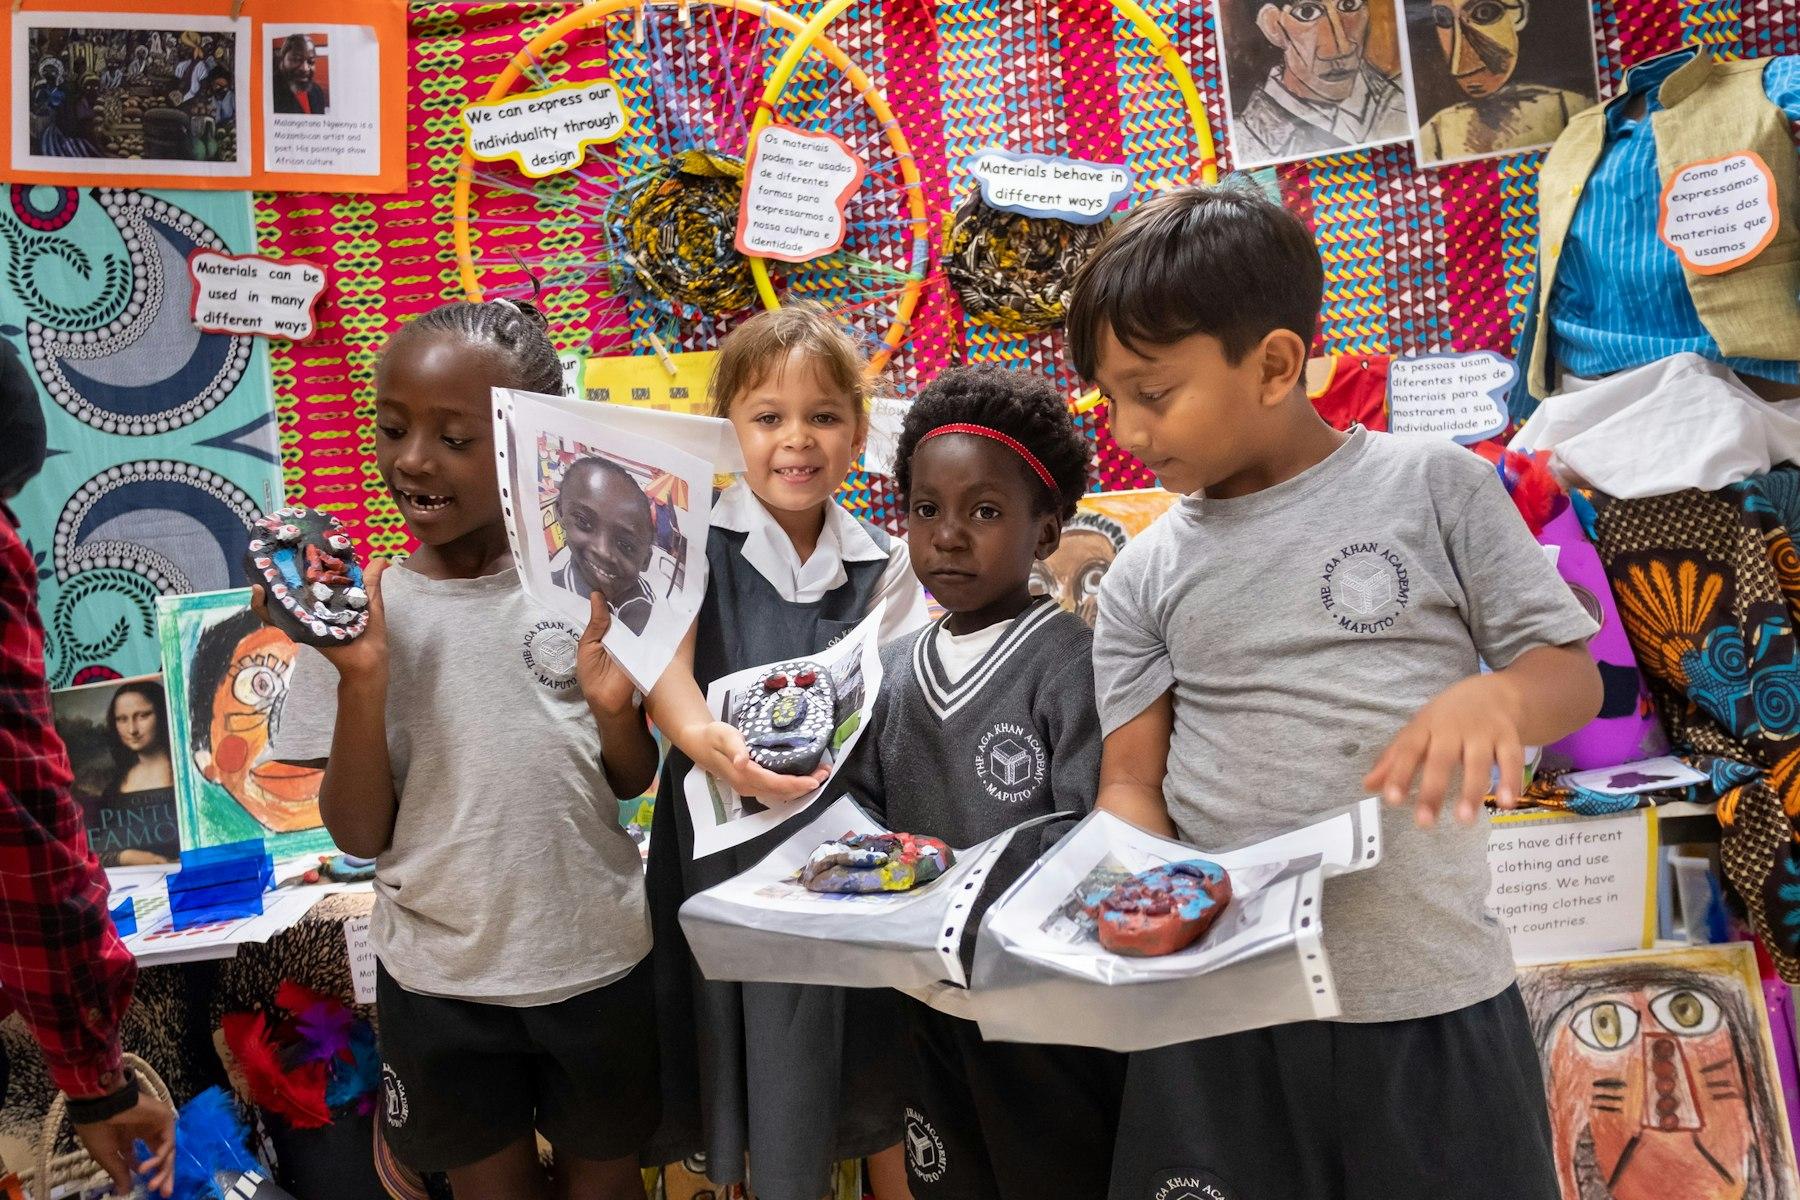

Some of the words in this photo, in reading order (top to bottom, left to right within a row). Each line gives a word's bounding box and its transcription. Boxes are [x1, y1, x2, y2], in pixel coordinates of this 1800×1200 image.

[467, 111, 492, 124] We
[499, 107, 523, 119] can
[528, 93, 582, 114] express
[589, 88, 611, 100] our
[474, 126, 557, 151] individuality
[564, 112, 619, 134] through
[764, 134, 778, 144] Os
[783, 139, 829, 153] materiais
[276, 157, 304, 165] African
[531, 150, 575, 167] design
[762, 153, 794, 165] podem
[818, 162, 851, 173] usados
[760, 169, 772, 179] de
[777, 172, 829, 188] diferentes
[979, 162, 1047, 178] Materials
[1054, 167, 1103, 182] behave
[1111, 171, 1123, 183] in
[1683, 169, 1718, 183] Como
[1724, 159, 1746, 173] nos
[758, 185, 793, 199] formas
[798, 194, 820, 204] para
[995, 188, 1062, 205] different
[1069, 198, 1103, 210] ways
[756, 204, 823, 222] expressarmos
[1676, 205, 1729, 223] através
[1736, 197, 1759, 211] dos
[753, 221, 780, 232] nossa
[785, 226, 820, 238] cultura
[1671, 223, 1737, 242] materiais
[1744, 216, 1767, 231] que
[751, 237, 803, 251] identidade
[1695, 241, 1746, 257] usamos
[197, 262, 257, 278] Materials
[269, 270, 291, 280] can
[303, 271, 319, 283] be
[208, 290, 237, 300] used
[248, 291, 259, 302] in
[271, 295, 305, 309] many
[203, 312, 263, 327] different
[275, 320, 307, 334] ways
[1393, 363, 1406, 372] As
[1411, 362, 1456, 374] pessoas
[1461, 357, 1490, 368] usam
[1393, 377, 1453, 387] diferentes
[1459, 374, 1487, 385] tipos
[1493, 370, 1507, 379] de
[1393, 391, 1447, 402] materiais
[1452, 391, 1478, 404] para
[1393, 408, 1456, 417] mostrarem
[1393, 419, 1479, 433] individualidade
[1484, 418, 1497, 426] na
[1340, 543, 1378, 559] KHAN
[1380, 549, 1410, 608] ACADEMY
[535, 621, 565, 631] KHAN
[1338, 616, 1394, 634] MAPUTO
[539, 674, 577, 690] MAPUTO
[994, 723, 1024, 736] KHAN
[978, 732, 994, 753] AGA
[975, 755, 987, 778] THE
[1024, 734, 1046, 785] ACADEMY
[986, 783, 1031, 803] MAPUTO
[1518, 838, 1551, 850] have
[1555, 830, 1623, 847] different
[1497, 859, 1553, 874] clothing
[1557, 855, 1581, 868] and
[1586, 854, 1610, 865] use
[1556, 878, 1580, 889] We
[1584, 874, 1615, 886] have
[1552, 894, 1602, 911] clothes
[1607, 892, 1619, 903] in
[1166, 1177, 1200, 1190] KHAN
